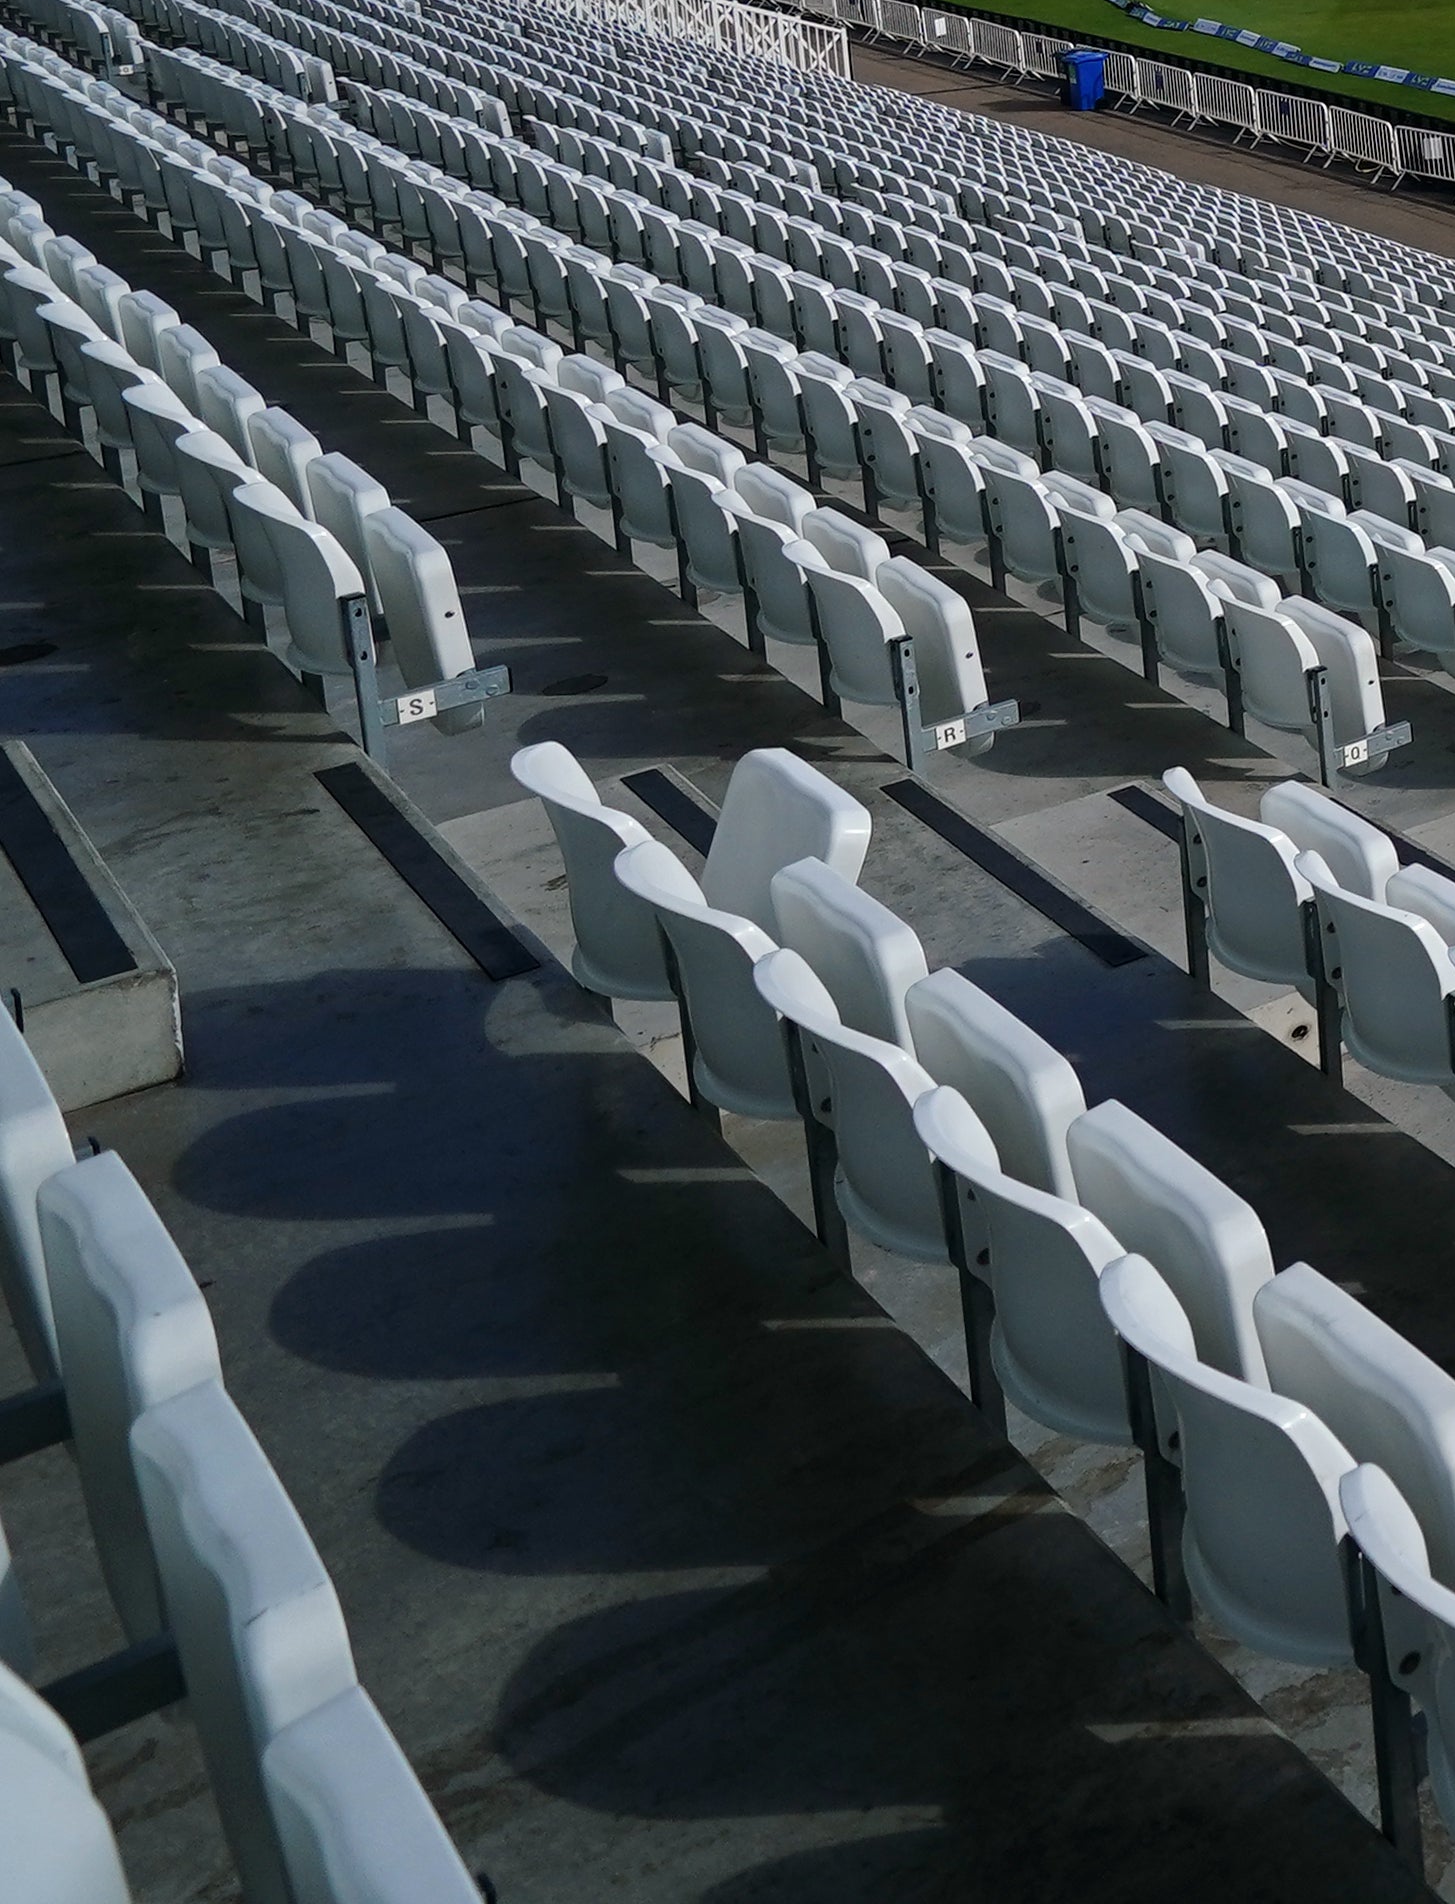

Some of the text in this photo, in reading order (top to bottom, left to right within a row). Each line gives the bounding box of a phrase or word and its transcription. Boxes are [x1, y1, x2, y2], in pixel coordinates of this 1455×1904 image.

[409, 698, 424, 715] S
[943, 728, 956, 743] R
[1350, 747, 1360, 761] Q
